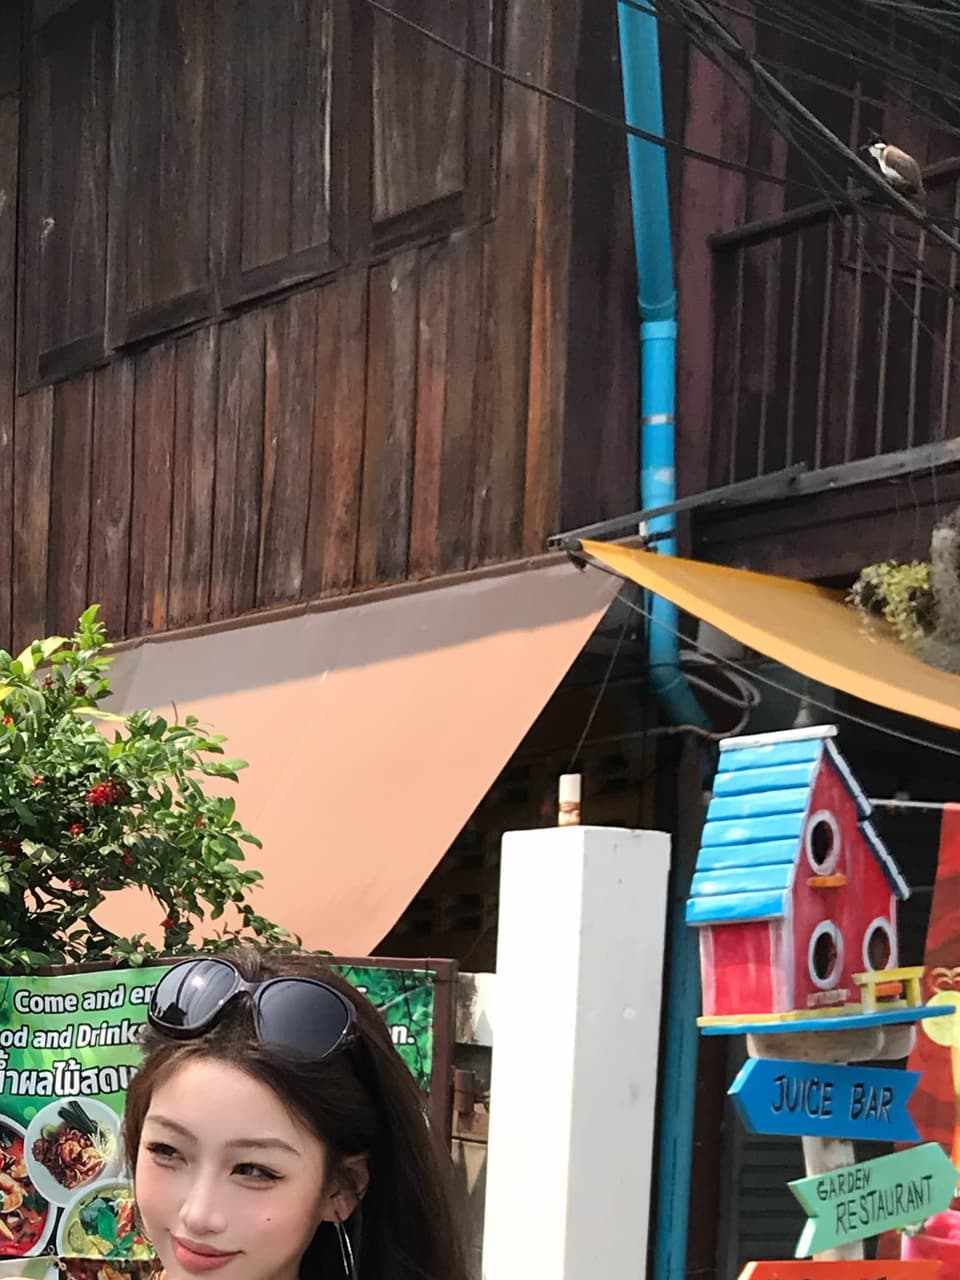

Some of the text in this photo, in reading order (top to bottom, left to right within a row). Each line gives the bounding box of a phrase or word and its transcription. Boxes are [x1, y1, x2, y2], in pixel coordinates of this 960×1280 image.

[14, 991, 77, 1014] Come
[82, 984, 124, 1010] and
[33, 1026, 71, 1048] and
[771, 1074, 894, 1122] JUICE BAR
[816, 1167, 871, 1201] GARDEN
[835, 1173, 933, 1237] RESTAURANT
